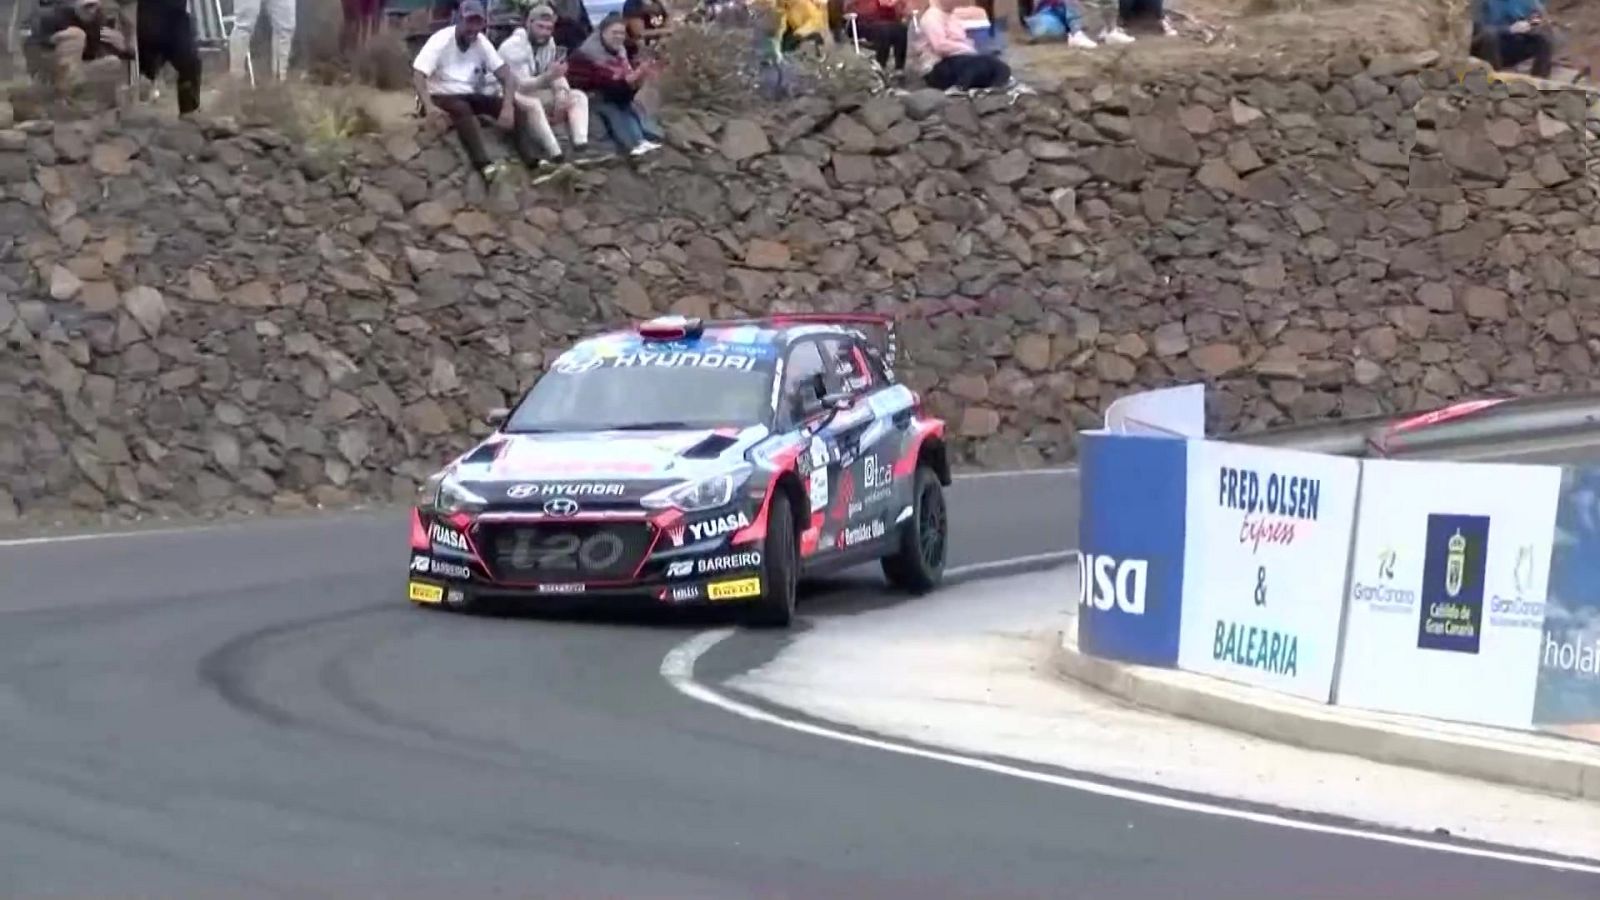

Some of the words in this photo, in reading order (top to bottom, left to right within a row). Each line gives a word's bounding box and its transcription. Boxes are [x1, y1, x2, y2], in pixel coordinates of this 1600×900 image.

[614, 352, 757, 372] HYUNDAI
[541, 484, 625, 496] HYUNDAI
[431, 523, 468, 550] YUASA
[689, 512, 749, 540] YUASA
[1239, 513, 1296, 555] Express
[698, 552, 761, 574] BARREIRO
[1254, 565, 1267, 607] &
